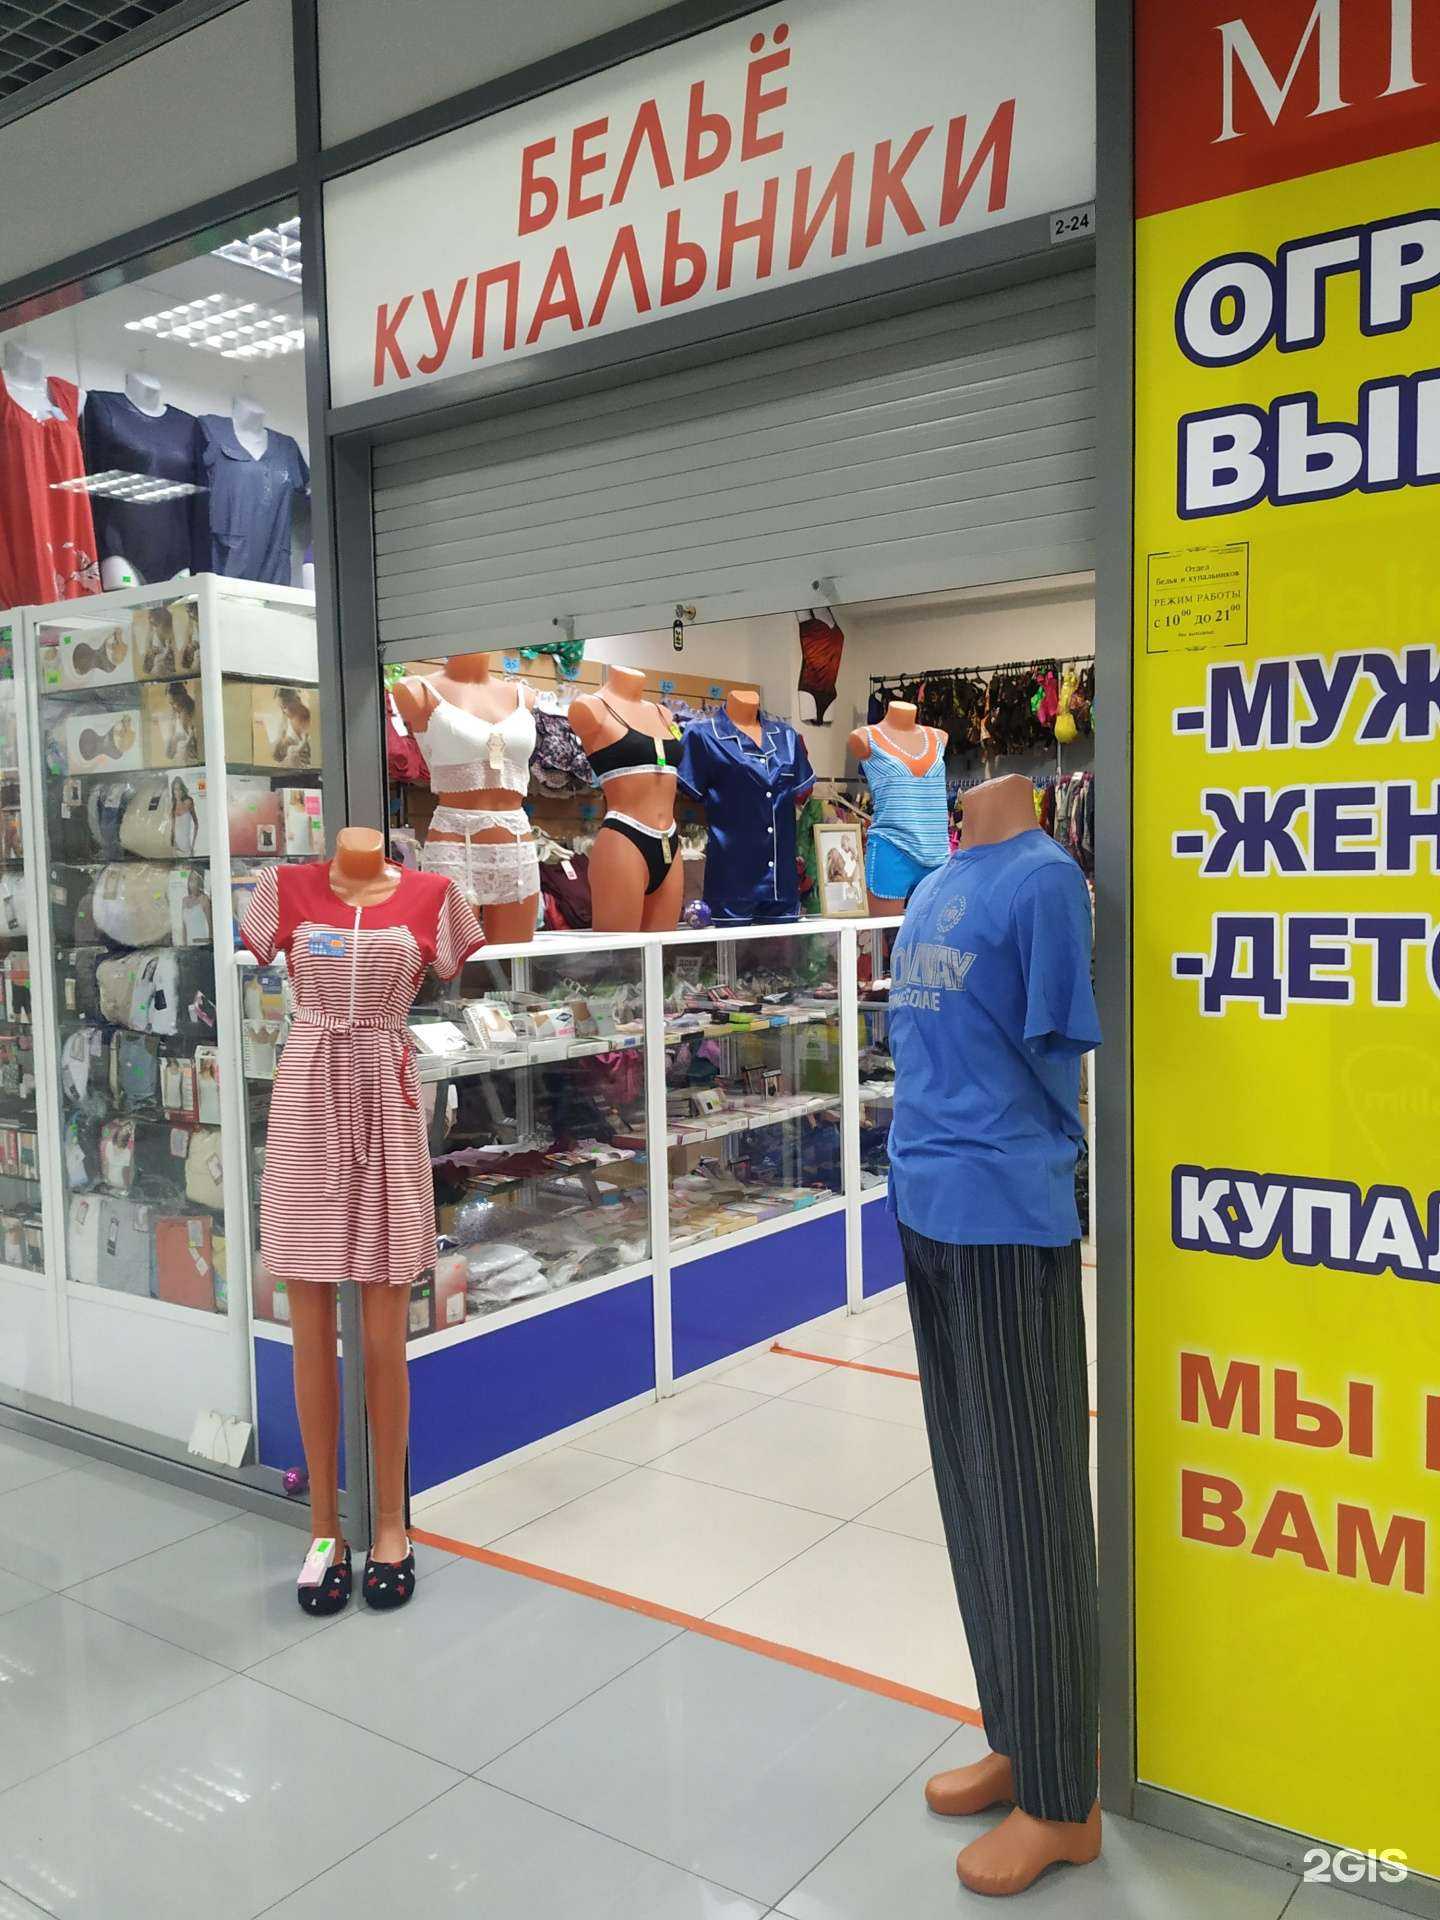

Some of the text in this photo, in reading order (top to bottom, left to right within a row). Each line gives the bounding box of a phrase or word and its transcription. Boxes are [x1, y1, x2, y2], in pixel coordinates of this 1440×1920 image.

[516, 23, 791, 237] БЕЛЬЁ
[372, 98, 1017, 388] КУПАЛЬНИКИ
[1055, 213, 1089, 235] 2-24
[1154, 589, 1241, 606] РЕЖИМ РАБОТЫ
[1173, 913, 1440, 1019] -ДЕТ
[1173, 1165, 1440, 1283] КУПА
[1180, 1352, 1374, 1458] МЫ
[1181, 1468, 1426, 1596] ВАМ
